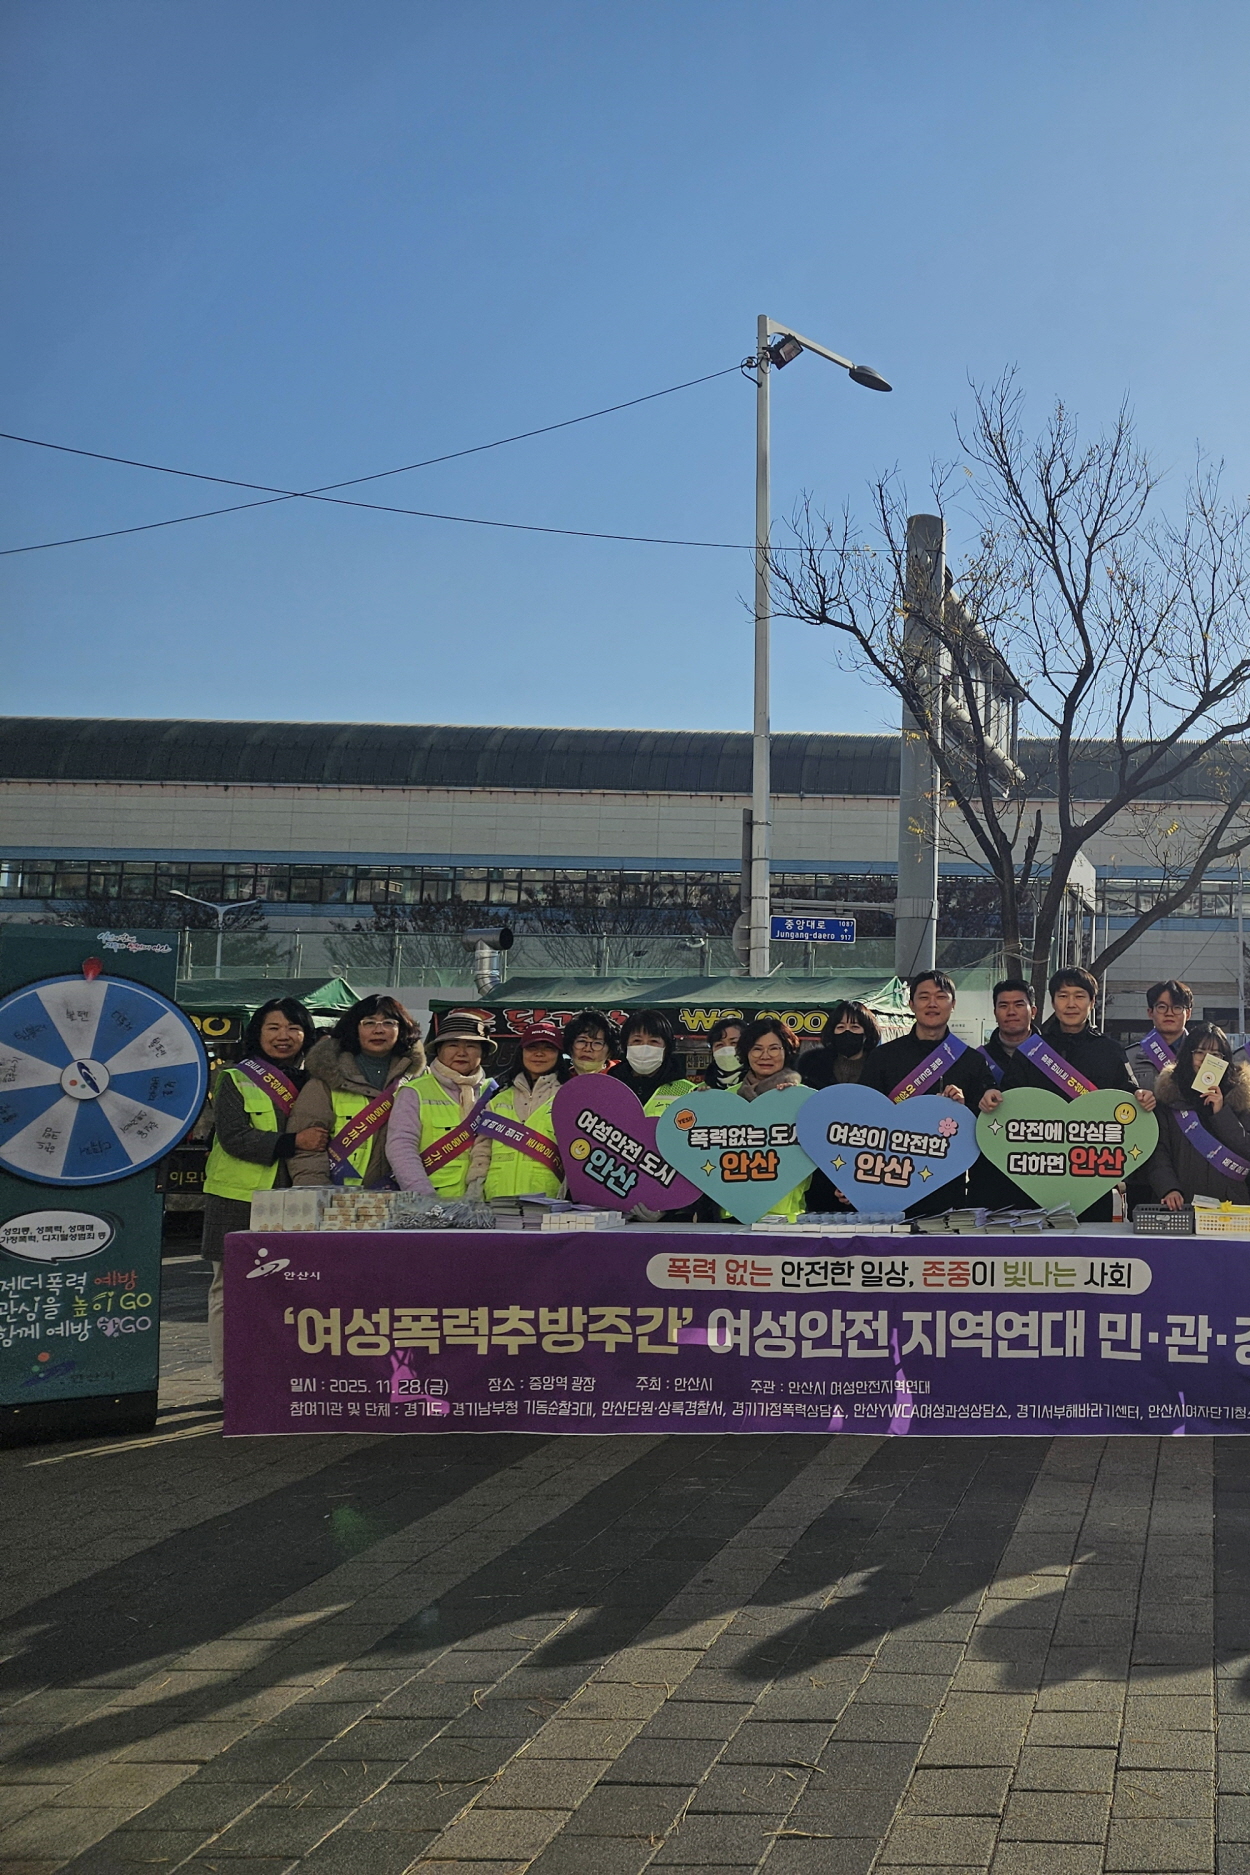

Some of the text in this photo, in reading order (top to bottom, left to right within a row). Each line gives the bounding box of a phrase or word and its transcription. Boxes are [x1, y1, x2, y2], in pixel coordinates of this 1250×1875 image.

[775, 930, 835, 940] Jungang-daero
[784, 919, 826, 931] 중앙대로
[341, 1100, 392, 1148] 존중은 가까이
[678, 1115, 693, 1125] YES!!
[690, 1127, 765, 1148] 폭력없는
[828, 1123, 948, 1157] 여성이 안전한
[1007, 1121, 1125, 1143] 안전에 안심을
[423, 1130, 471, 1168] 존중은 가까
[577, 1110, 677, 1187] 여성안전 도시
[585, 1150, 637, 1197] 안산
[722, 1152, 778, 1180] 안산
[856, 1153, 913, 1186] 안산
[1009, 1147, 1126, 1177] 더하면 안산
[94, 1269, 138, 1291] 예방
[284, 1271, 320, 1281] 안산시
[667, 1258, 1132, 1289] 폭력 없는 안전한 일상, 존중이 빛나는 사회
[0, 1296, 62, 1321] 관심을
[0, 1319, 92, 1348] 함께 예방
[707, 1307, 889, 1358] 여성안전
[902, 1310, 1085, 1358] 지역연대
[290, 1378, 317, 1392] 일시
[329, 1379, 371, 1393] 2025.
[377, 1379, 396, 1394] 11.
[487, 1376, 596, 1392] 장소 중앙역 광장
[635, 1377, 713, 1392] 주최 안산시
[750, 1379, 930, 1395] 주관 안산시 여성안전지역연대
[289, 1401, 343, 1417] 참여기관
[348, 1401, 361, 1417] 및
[365, 1402, 391, 1417] 단체
[404, 1402, 447, 1418] 경기도,
[452, 1401, 518, 1417] 경기남부청
[525, 1400, 597, 1418] 기동순찰3대,
[601, 1400, 726, 1418] 안산단원·상록경찰서,
[732, 1402, 849, 1419] 경기가정폭력상담소,
[853, 1402, 1011, 1420] 안산YWCA여성과성상담소,
[1016, 1403, 1143, 1421] 경기서부해바라기센터,
